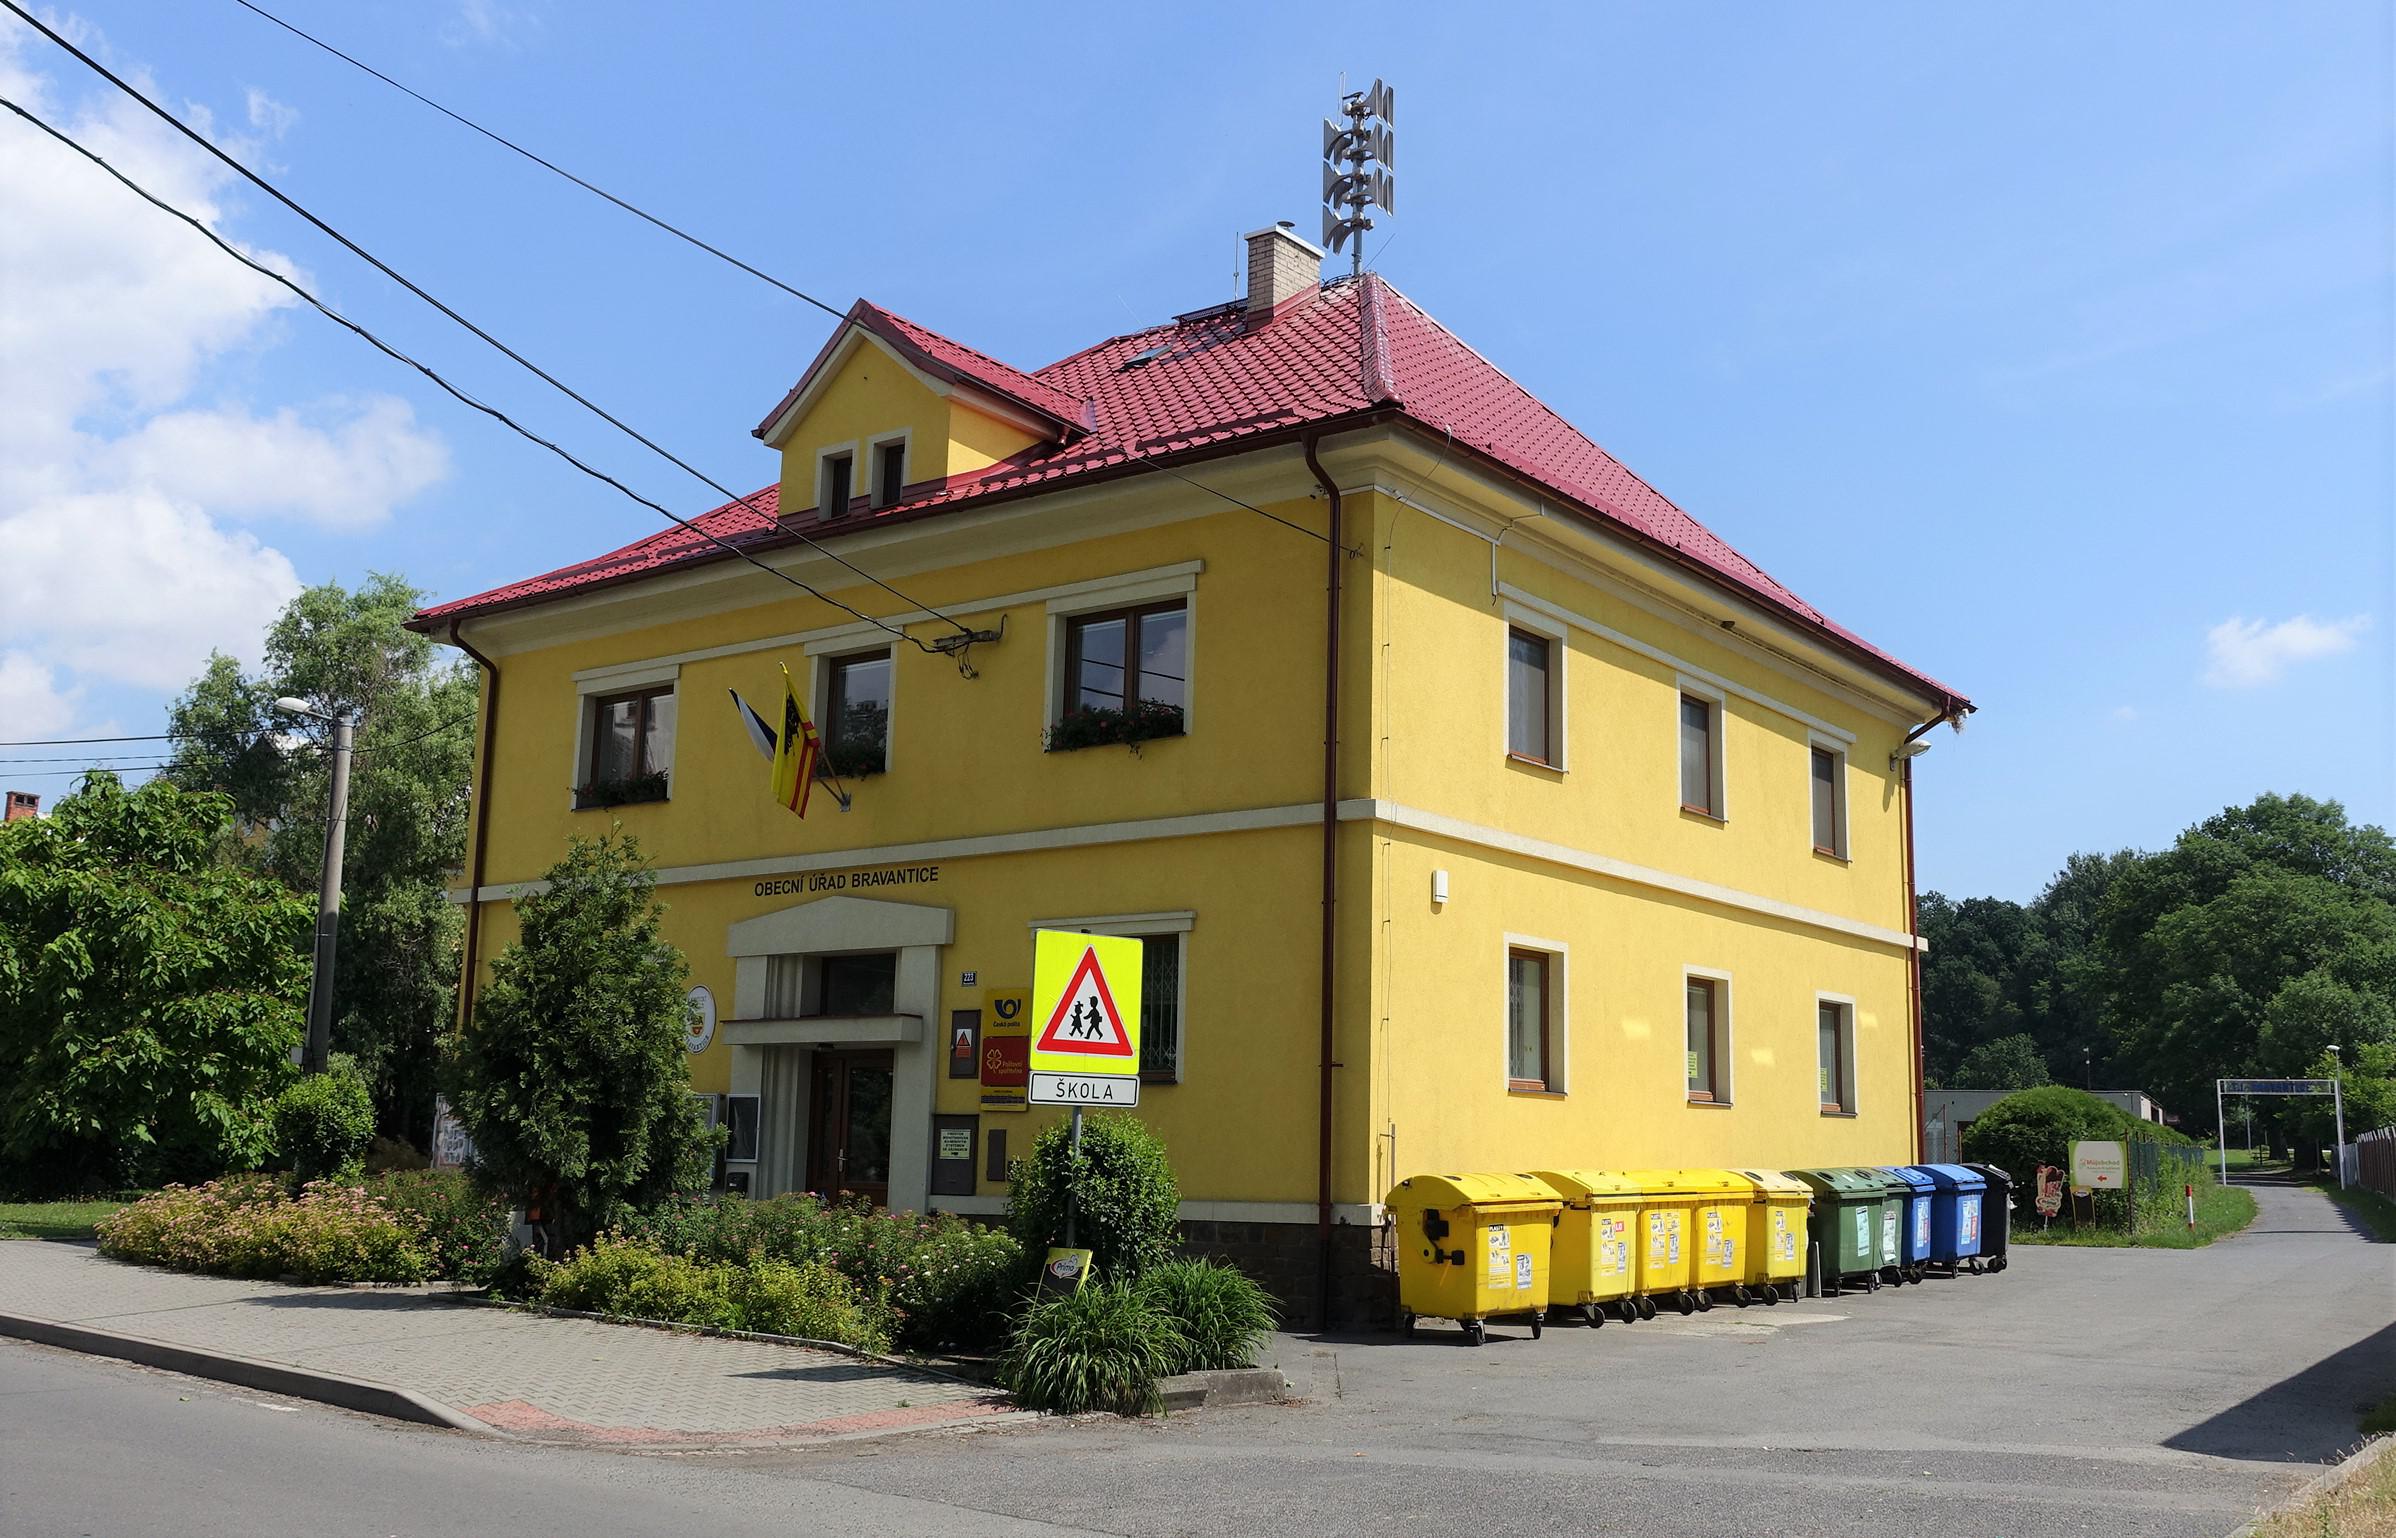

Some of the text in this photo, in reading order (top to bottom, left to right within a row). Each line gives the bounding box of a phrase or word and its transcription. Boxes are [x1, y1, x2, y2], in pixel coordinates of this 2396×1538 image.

[754, 866, 939, 897] OBECNÍ ÚŘAD BRAVANTICE
[1055, 1078, 1113, 1101] ŠKOLA
